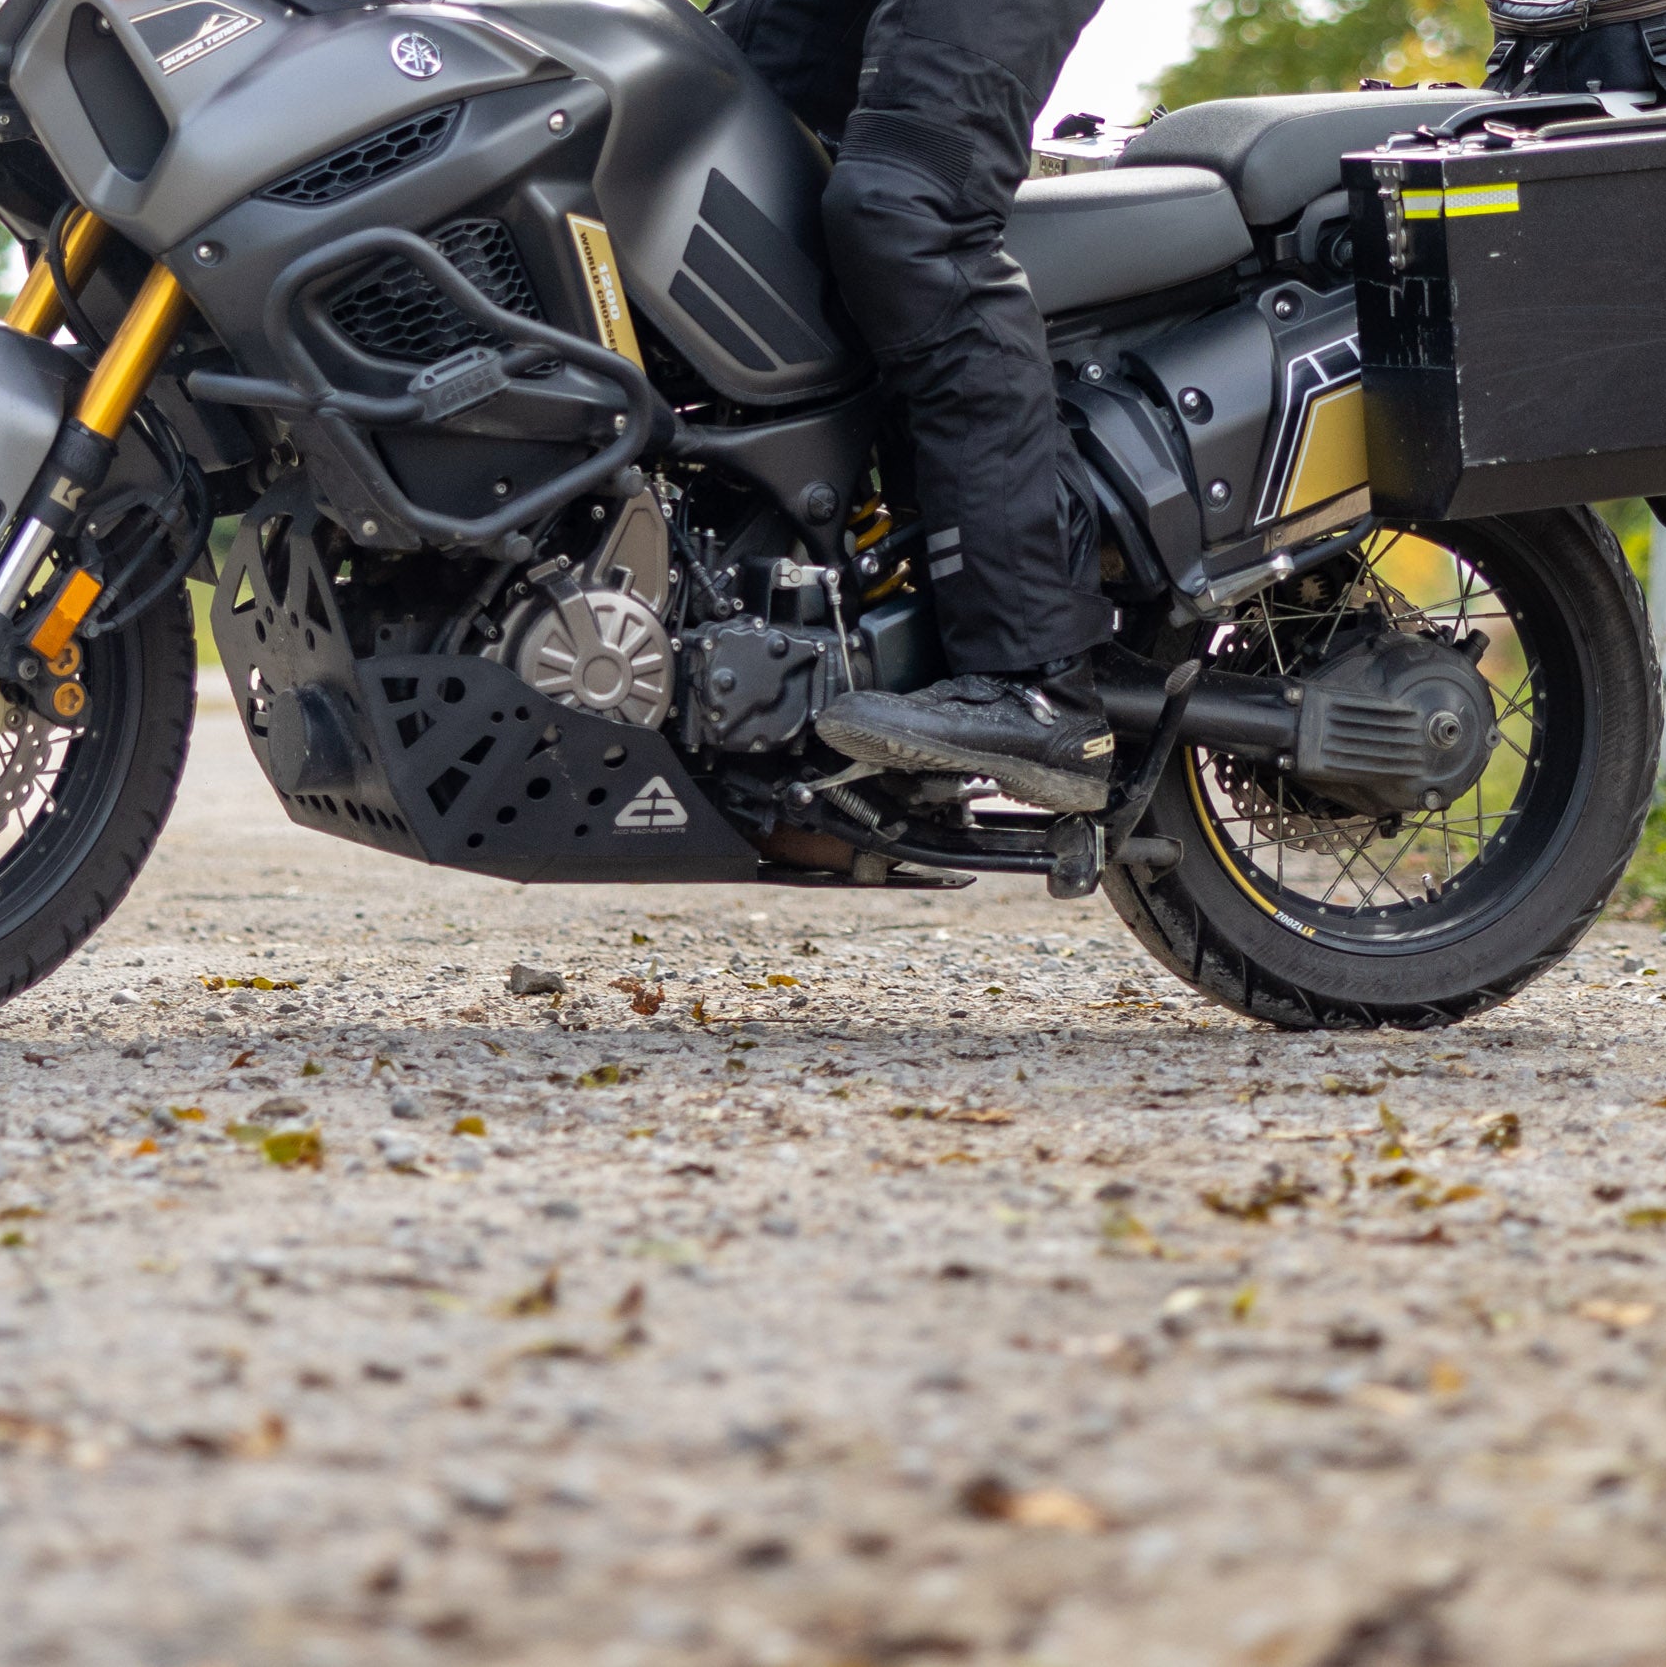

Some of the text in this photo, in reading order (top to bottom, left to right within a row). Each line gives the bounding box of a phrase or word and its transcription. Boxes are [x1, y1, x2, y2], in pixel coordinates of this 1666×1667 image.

[162, 41, 204, 69] SUPER
[580, 232, 600, 284] WORLD
[599, 262, 621, 320] 1200
[1274, 911, 1317, 938] XT1200Z
